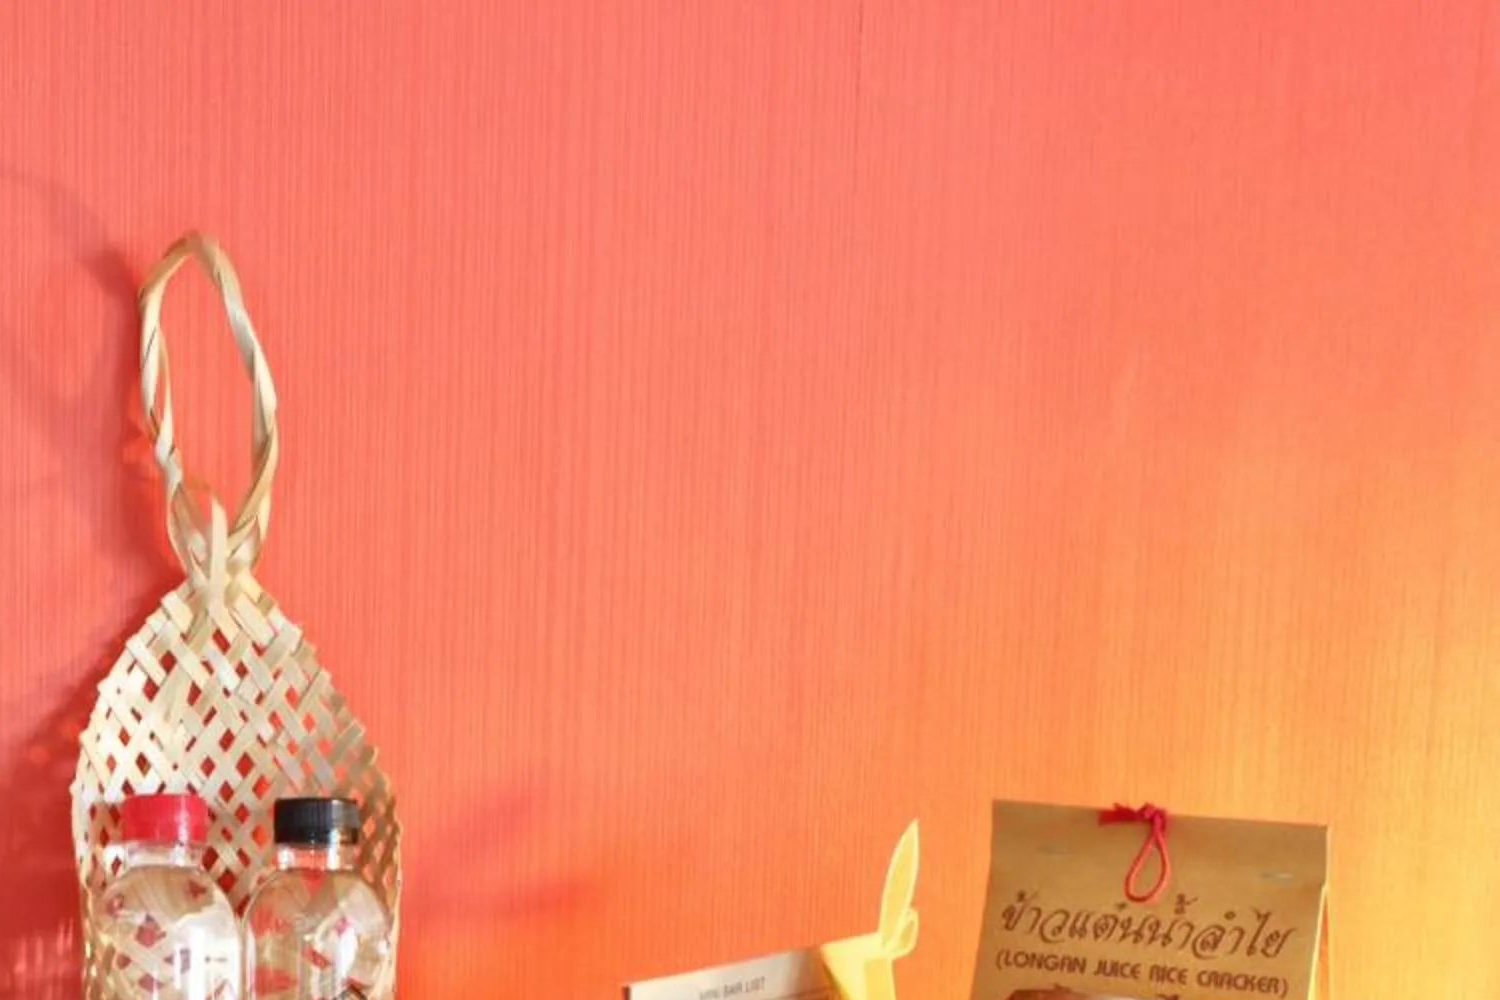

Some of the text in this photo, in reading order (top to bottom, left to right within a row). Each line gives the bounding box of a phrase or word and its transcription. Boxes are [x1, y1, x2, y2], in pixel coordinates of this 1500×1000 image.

[996, 949, 1087, 975] (LONGAN
[1093, 958, 1141, 980] JUICE
[1196, 969, 1289, 998] CRACKER)
